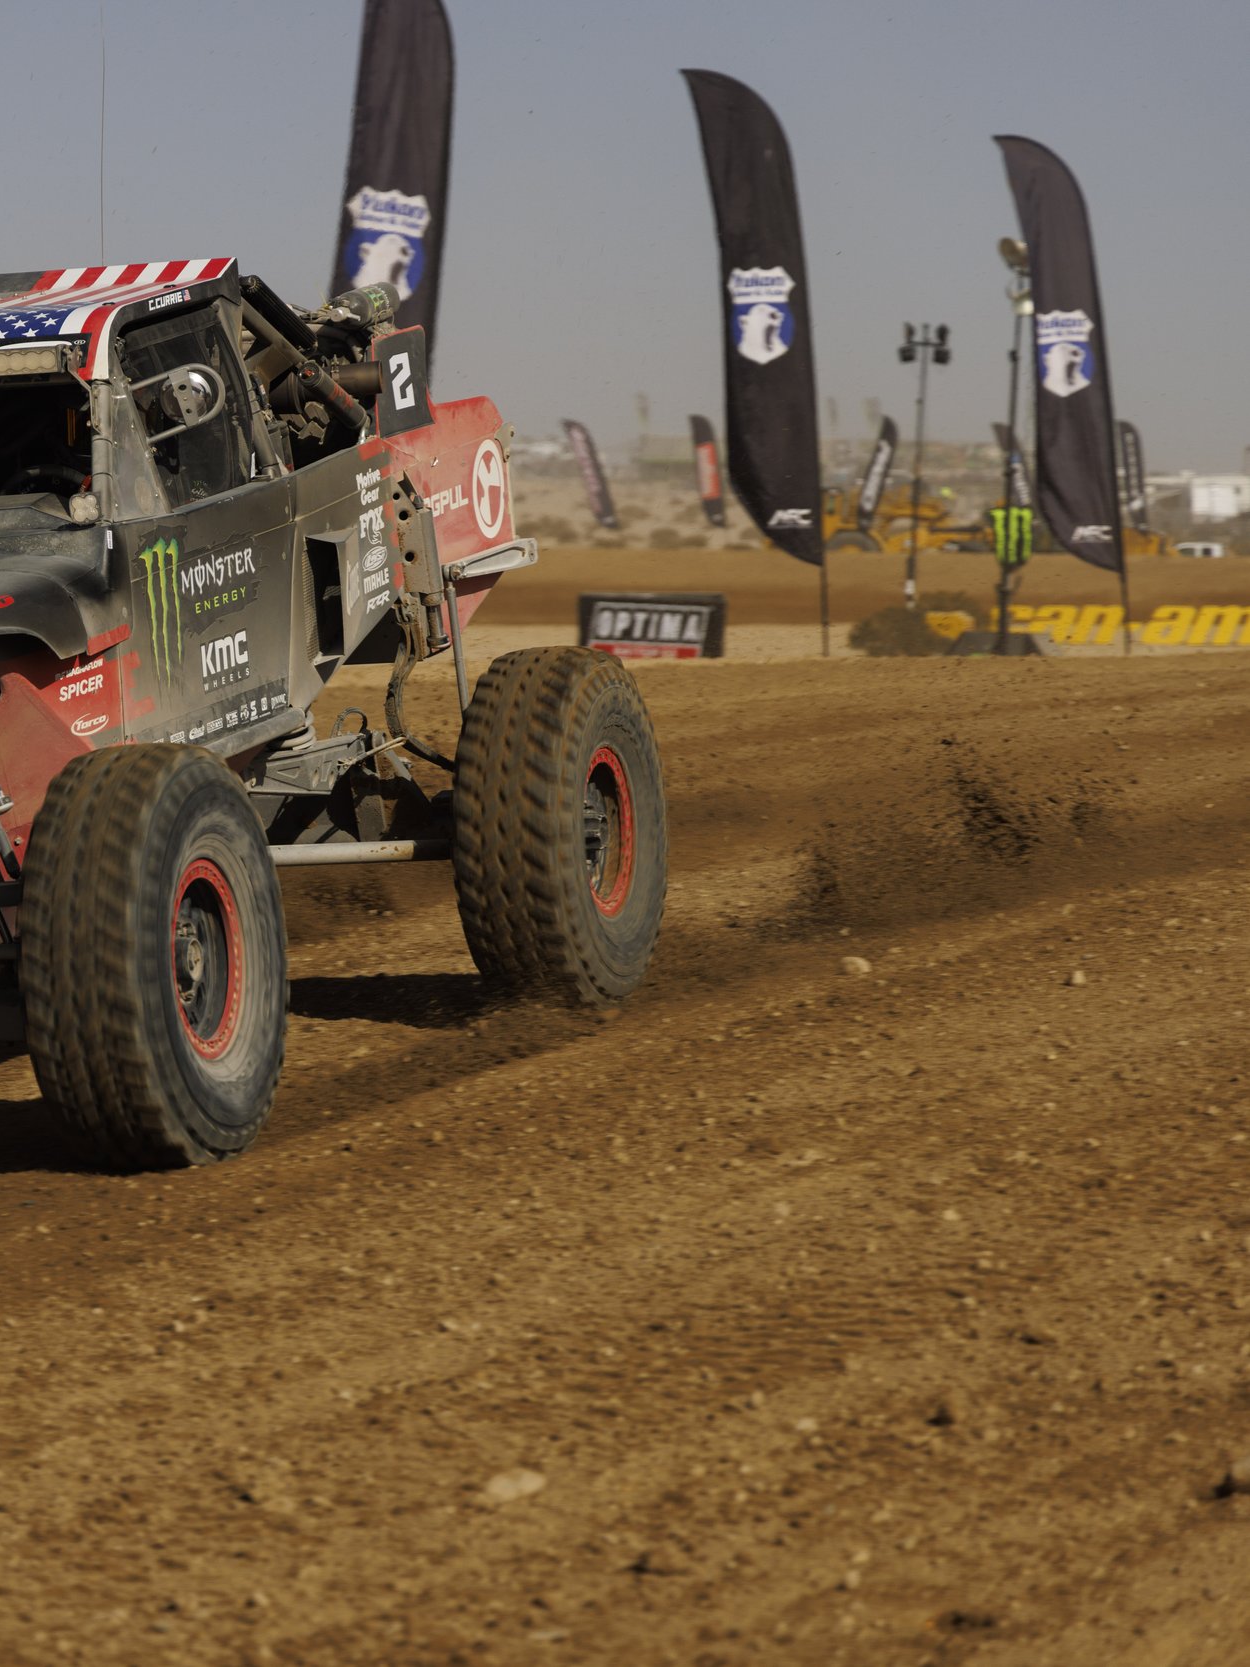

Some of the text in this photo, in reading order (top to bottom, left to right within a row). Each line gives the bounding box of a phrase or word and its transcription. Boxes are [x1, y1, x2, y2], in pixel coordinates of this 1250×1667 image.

[148, 291, 183, 311] C.CURRIE
[389, 352, 416, 411] 2
[355, 468, 381, 491] Motive
[360, 487, 379, 505] Gear
[423, 485, 469, 518] GPUL
[359, 505, 385, 540] FOX
[181, 548, 256, 596] MONSTER
[363, 568, 390, 594] MAHLE
[195, 586, 247, 614] ENERGY
[596, 609, 701, 641] OPTIMA
[59, 674, 104, 702] SPICER
[204, 667, 250, 691] WHEELS
[75, 714, 106, 731] Torco
